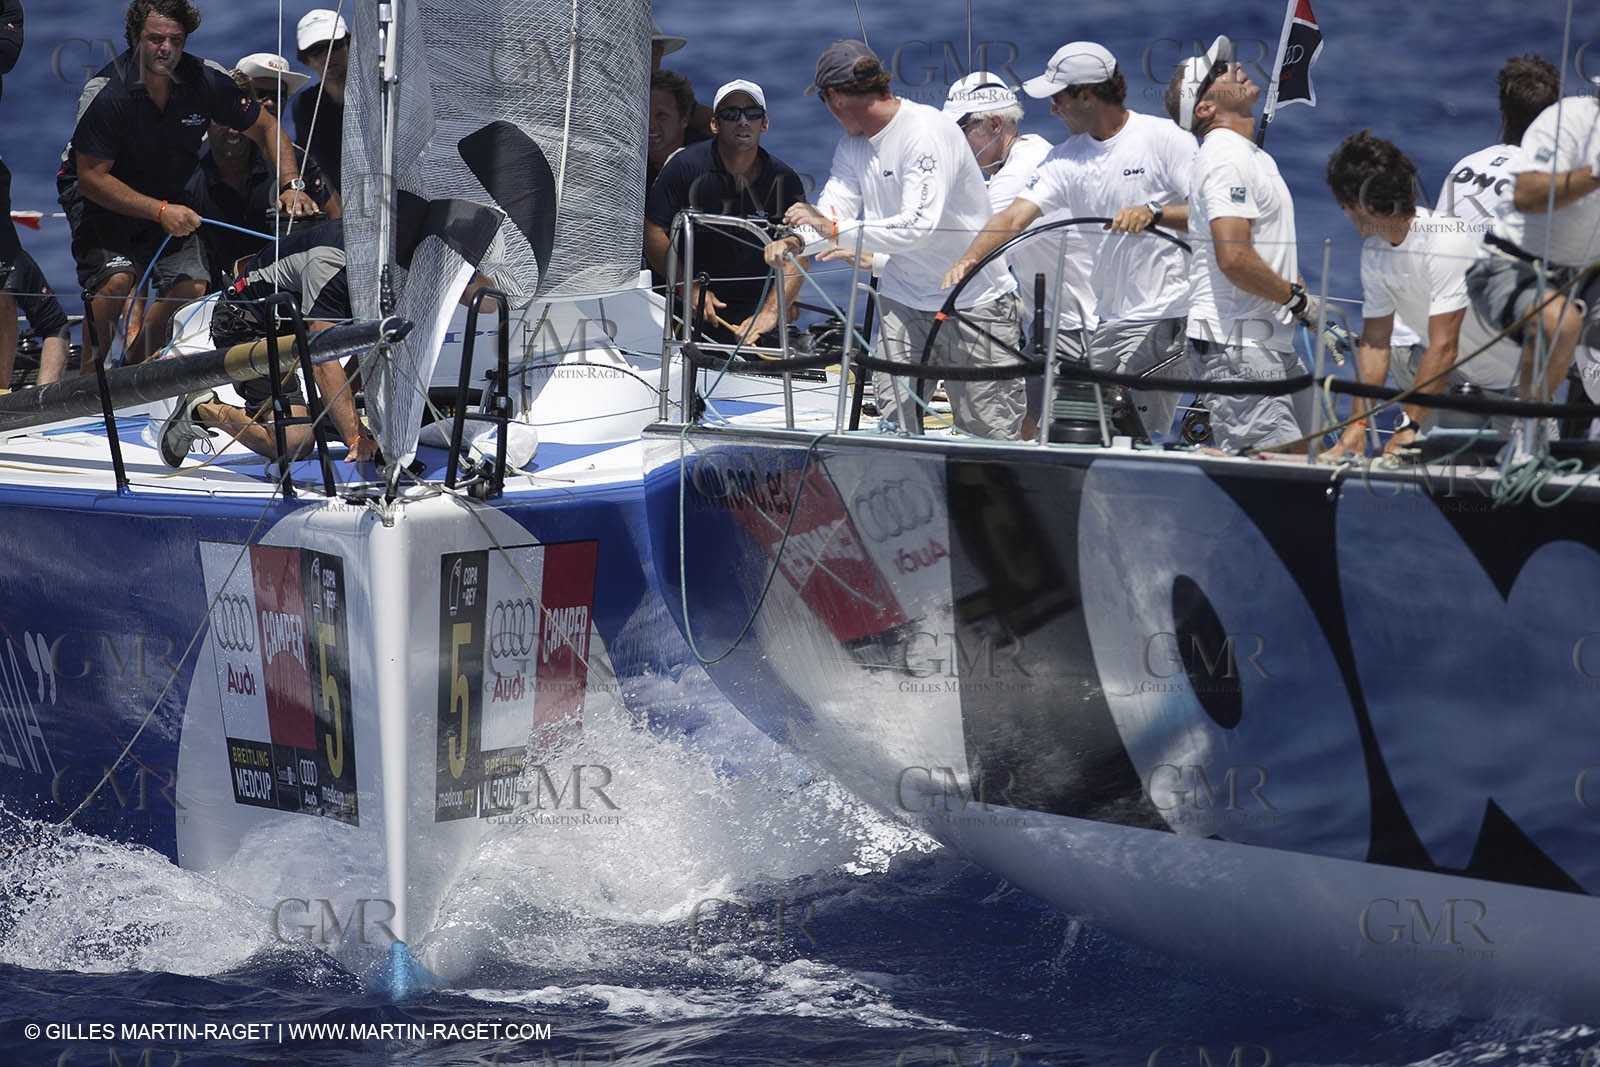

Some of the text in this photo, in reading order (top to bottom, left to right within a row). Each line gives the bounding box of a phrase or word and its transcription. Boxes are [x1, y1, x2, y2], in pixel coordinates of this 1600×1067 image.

[262, 610, 306, 671] CAMPER
[543, 605, 588, 664] CAMPER
[227, 662, 256, 696] Audi
[492, 670, 525, 703] Audi
[319, 622, 344, 778] 5
[448, 623, 473, 779] 5
[232, 747, 269, 766] BREITLING
[235, 768, 271, 800] MEDCUP
[483, 776, 518, 810] MEDCU
